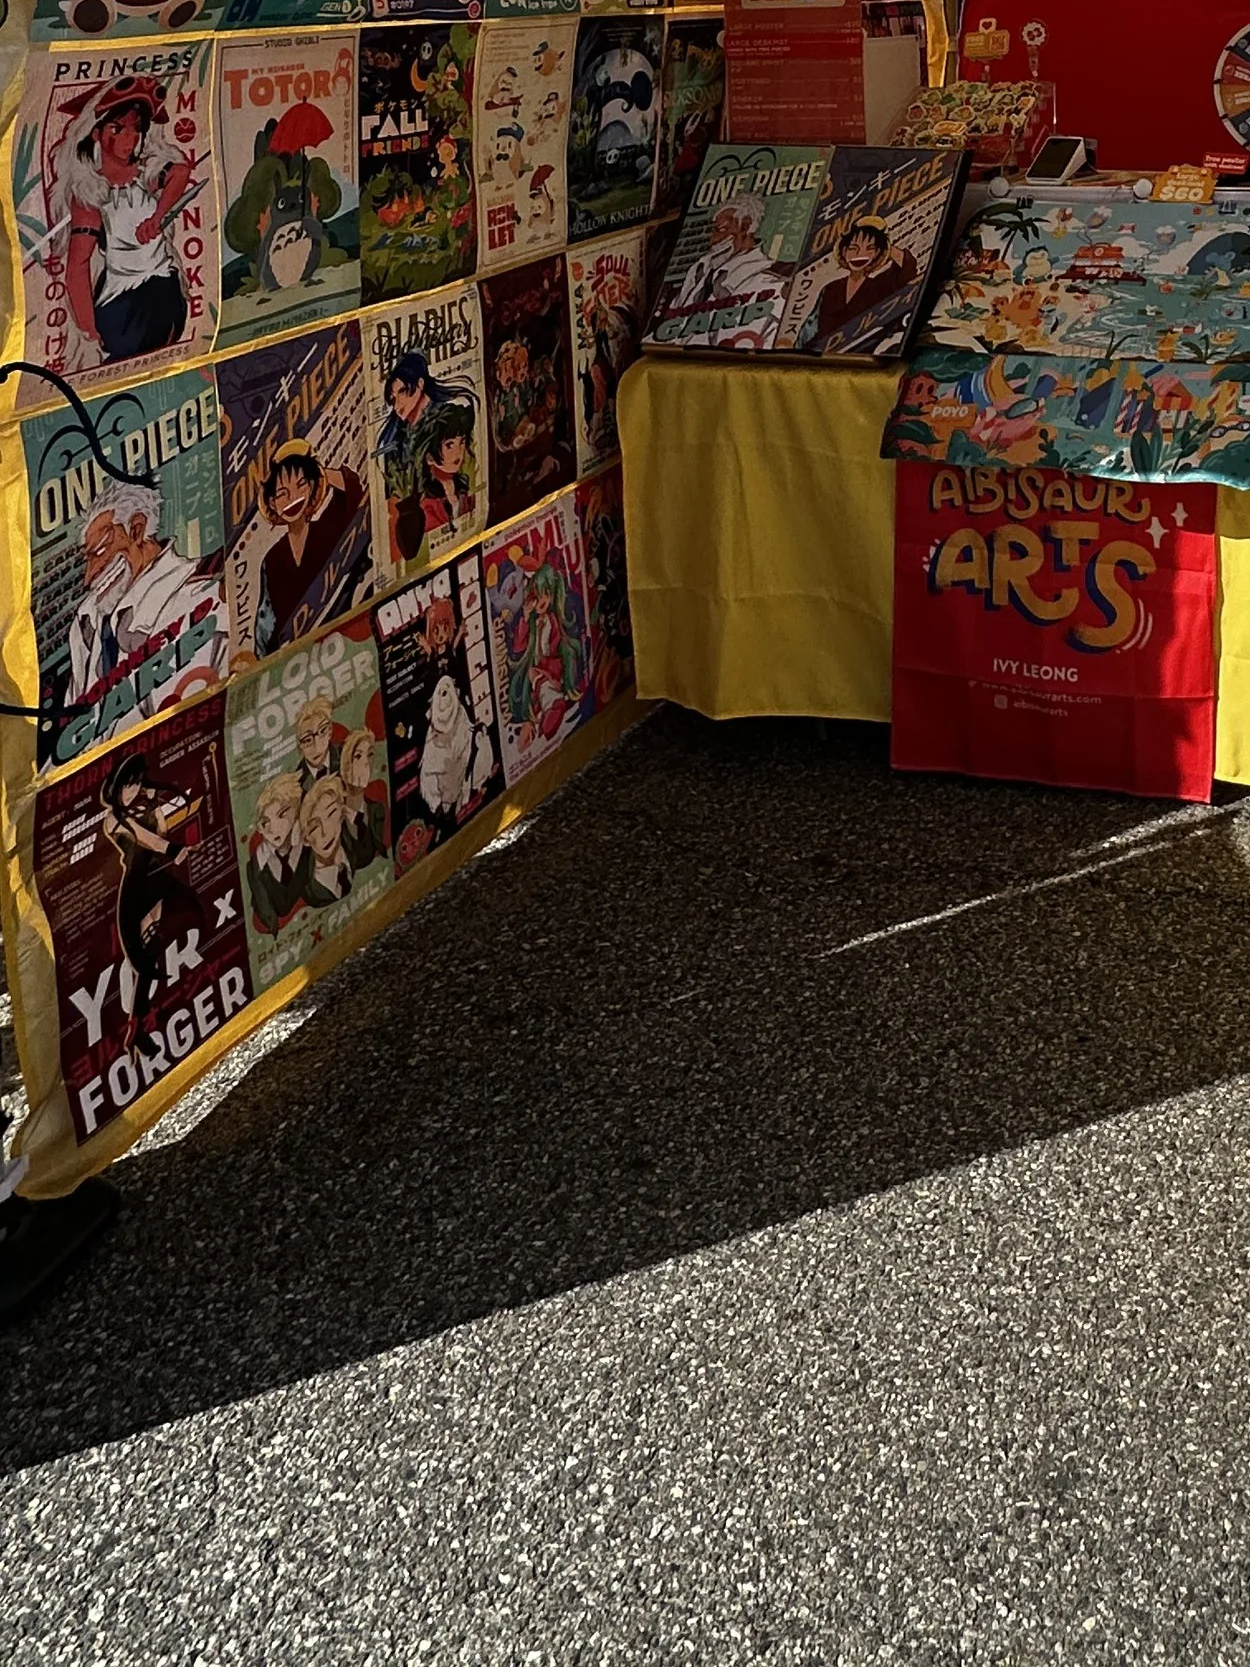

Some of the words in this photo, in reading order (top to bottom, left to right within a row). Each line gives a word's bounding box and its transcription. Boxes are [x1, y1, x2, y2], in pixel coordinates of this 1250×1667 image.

[55, 50, 193, 82] PRINCESS
[361, 109, 429, 140] FALL
[751, 160, 826, 197] PIECE
[873, 151, 947, 215] PIECE
[569, 215, 607, 236] HOLLOW
[610, 204, 651, 224] KNIGHT
[591, 254, 630, 292] SOUL
[653, 302, 775, 341] GARP
[80, 361, 128, 383] FOREST
[132, 346, 190, 369] PRINCESS
[286, 332, 351, 440] PIECE
[123, 387, 219, 475] PIECE
[235, 561, 253, 646] ワンピース
[928, 521, 1157, 654] ARTS
[55, 615, 218, 762] GARP
[258, 632, 345, 707] LOID
[993, 657, 1020, 676] IVY
[1022, 661, 1079, 683] LEONG
[258, 938, 303, 985] SPY
[78, 966, 248, 1135] FORGER
